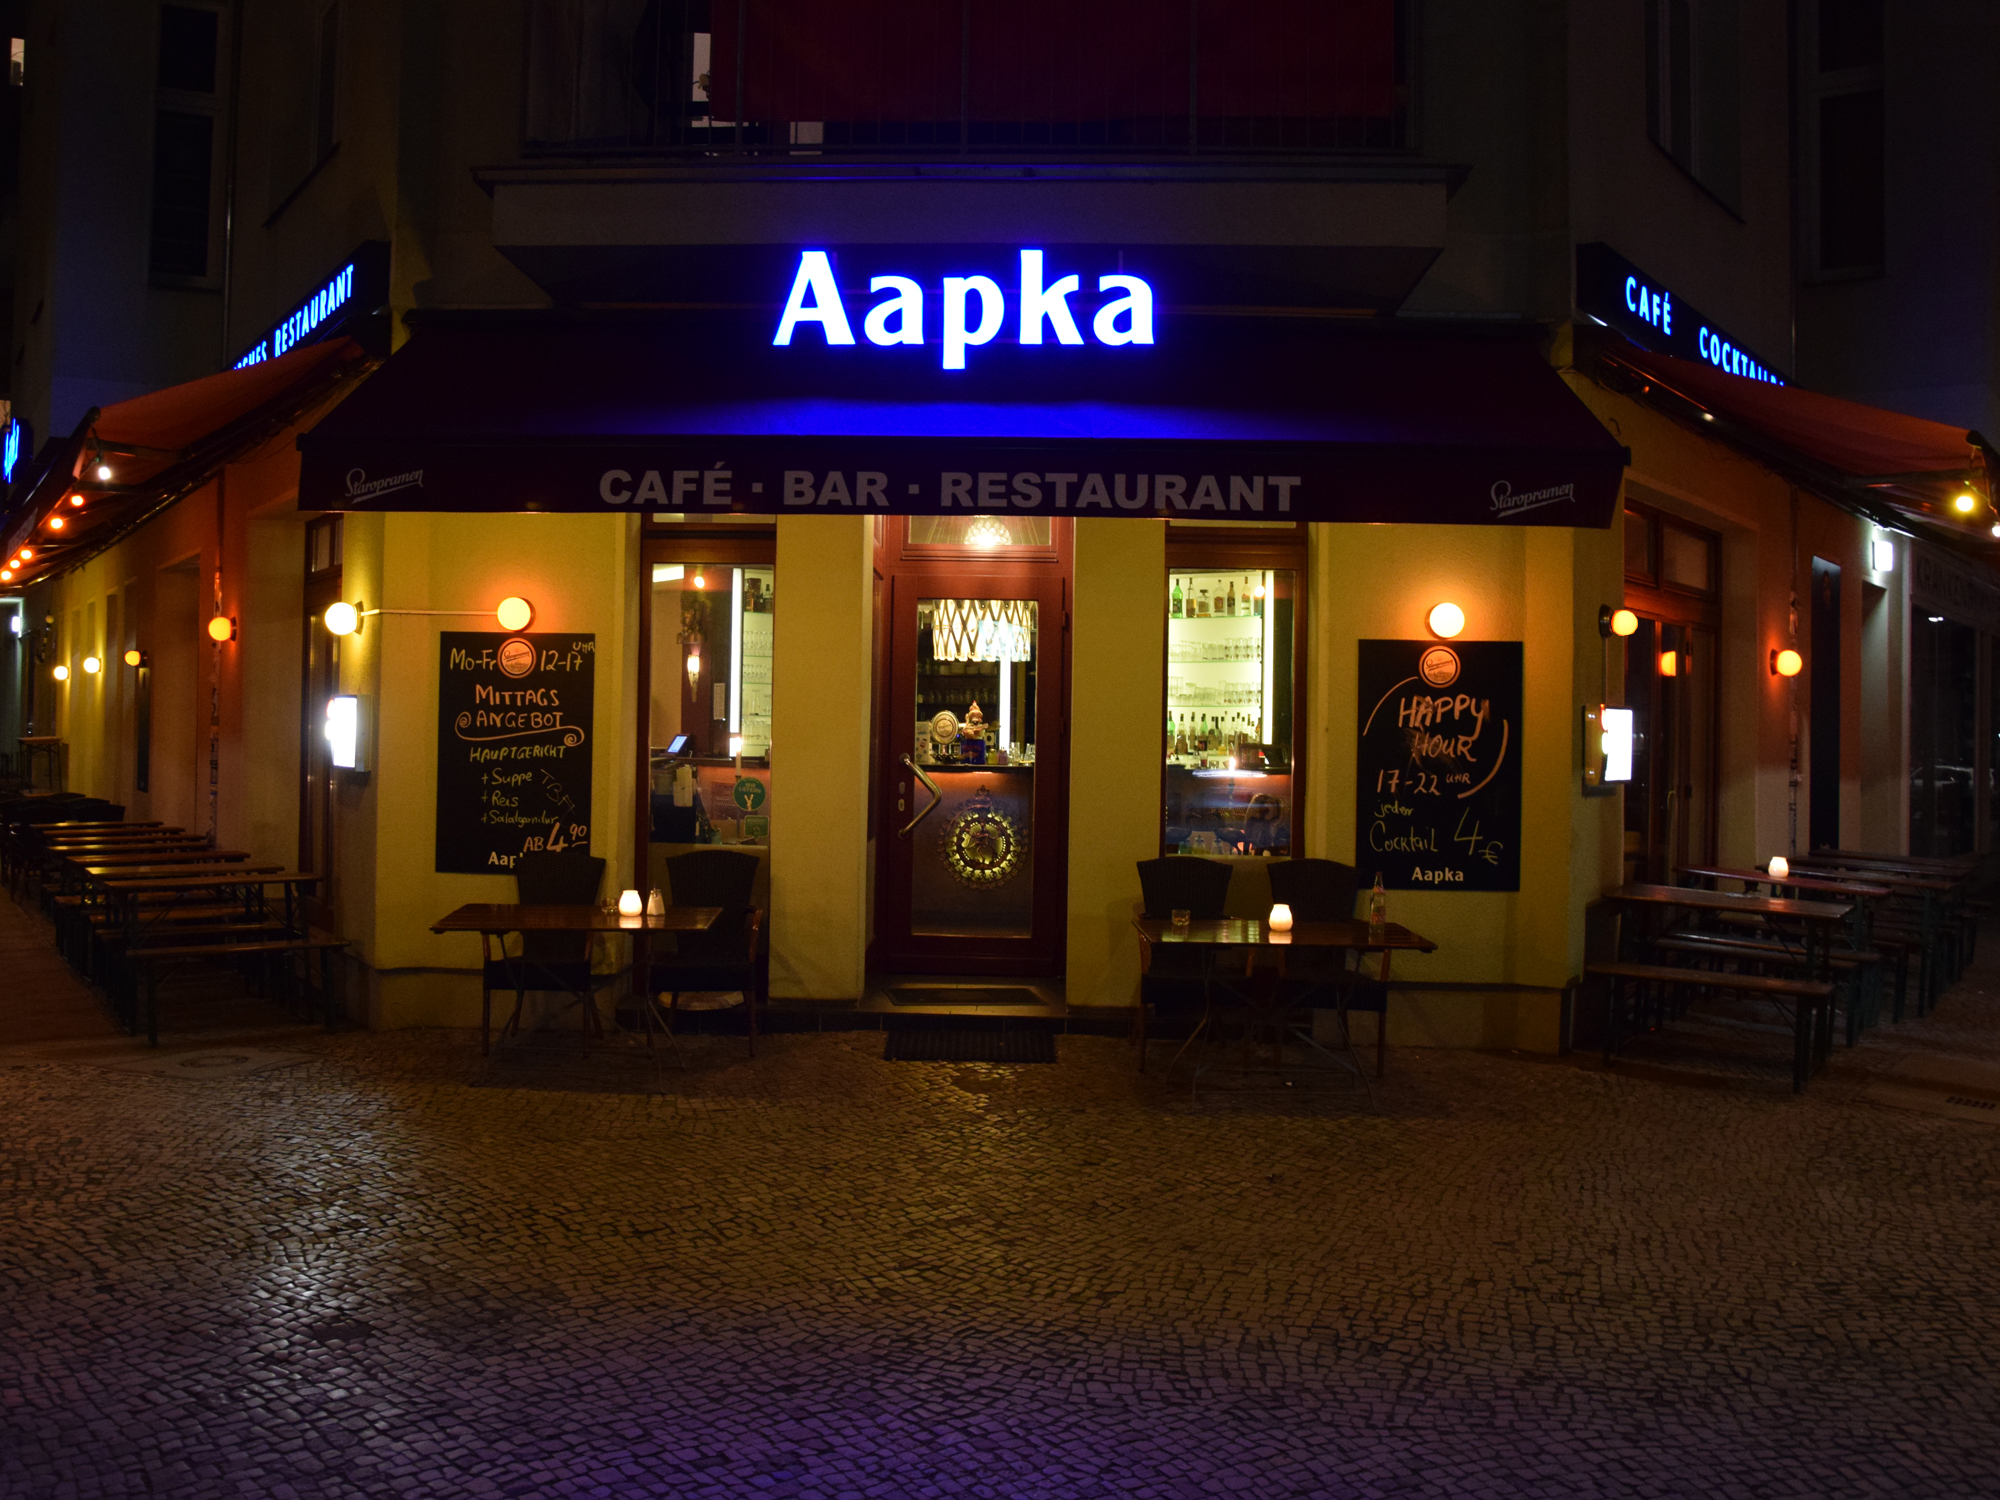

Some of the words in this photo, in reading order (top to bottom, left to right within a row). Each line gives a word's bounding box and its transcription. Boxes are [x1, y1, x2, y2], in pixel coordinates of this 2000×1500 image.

[274, 264, 354, 358] RESTAURANT
[773, 249, 1155, 369] Aapka
[1626, 276, 1671, 336] CAFÉ
[345, 467, 424, 504] Staropramen
[600, 462, 733, 505] CAFÉ
[783, 470, 890, 506] BAR
[940, 472, 1301, 511] RESTAURANT
[1489, 480, 1576, 518] Staropramen
[475, 684, 560, 706] MITTAGS
[476, 710, 563, 728] ANGEBOT
[470, 744, 566, 763] HAUPTGERICHT
[1411, 731, 1477, 762] HOUR
[491, 767, 533, 787] Suppe
[1376, 768, 1441, 796] 17-22
[491, 789, 519, 807] Reis
[523, 836, 545, 852] AB
[1411, 866, 1465, 885] Aapka
